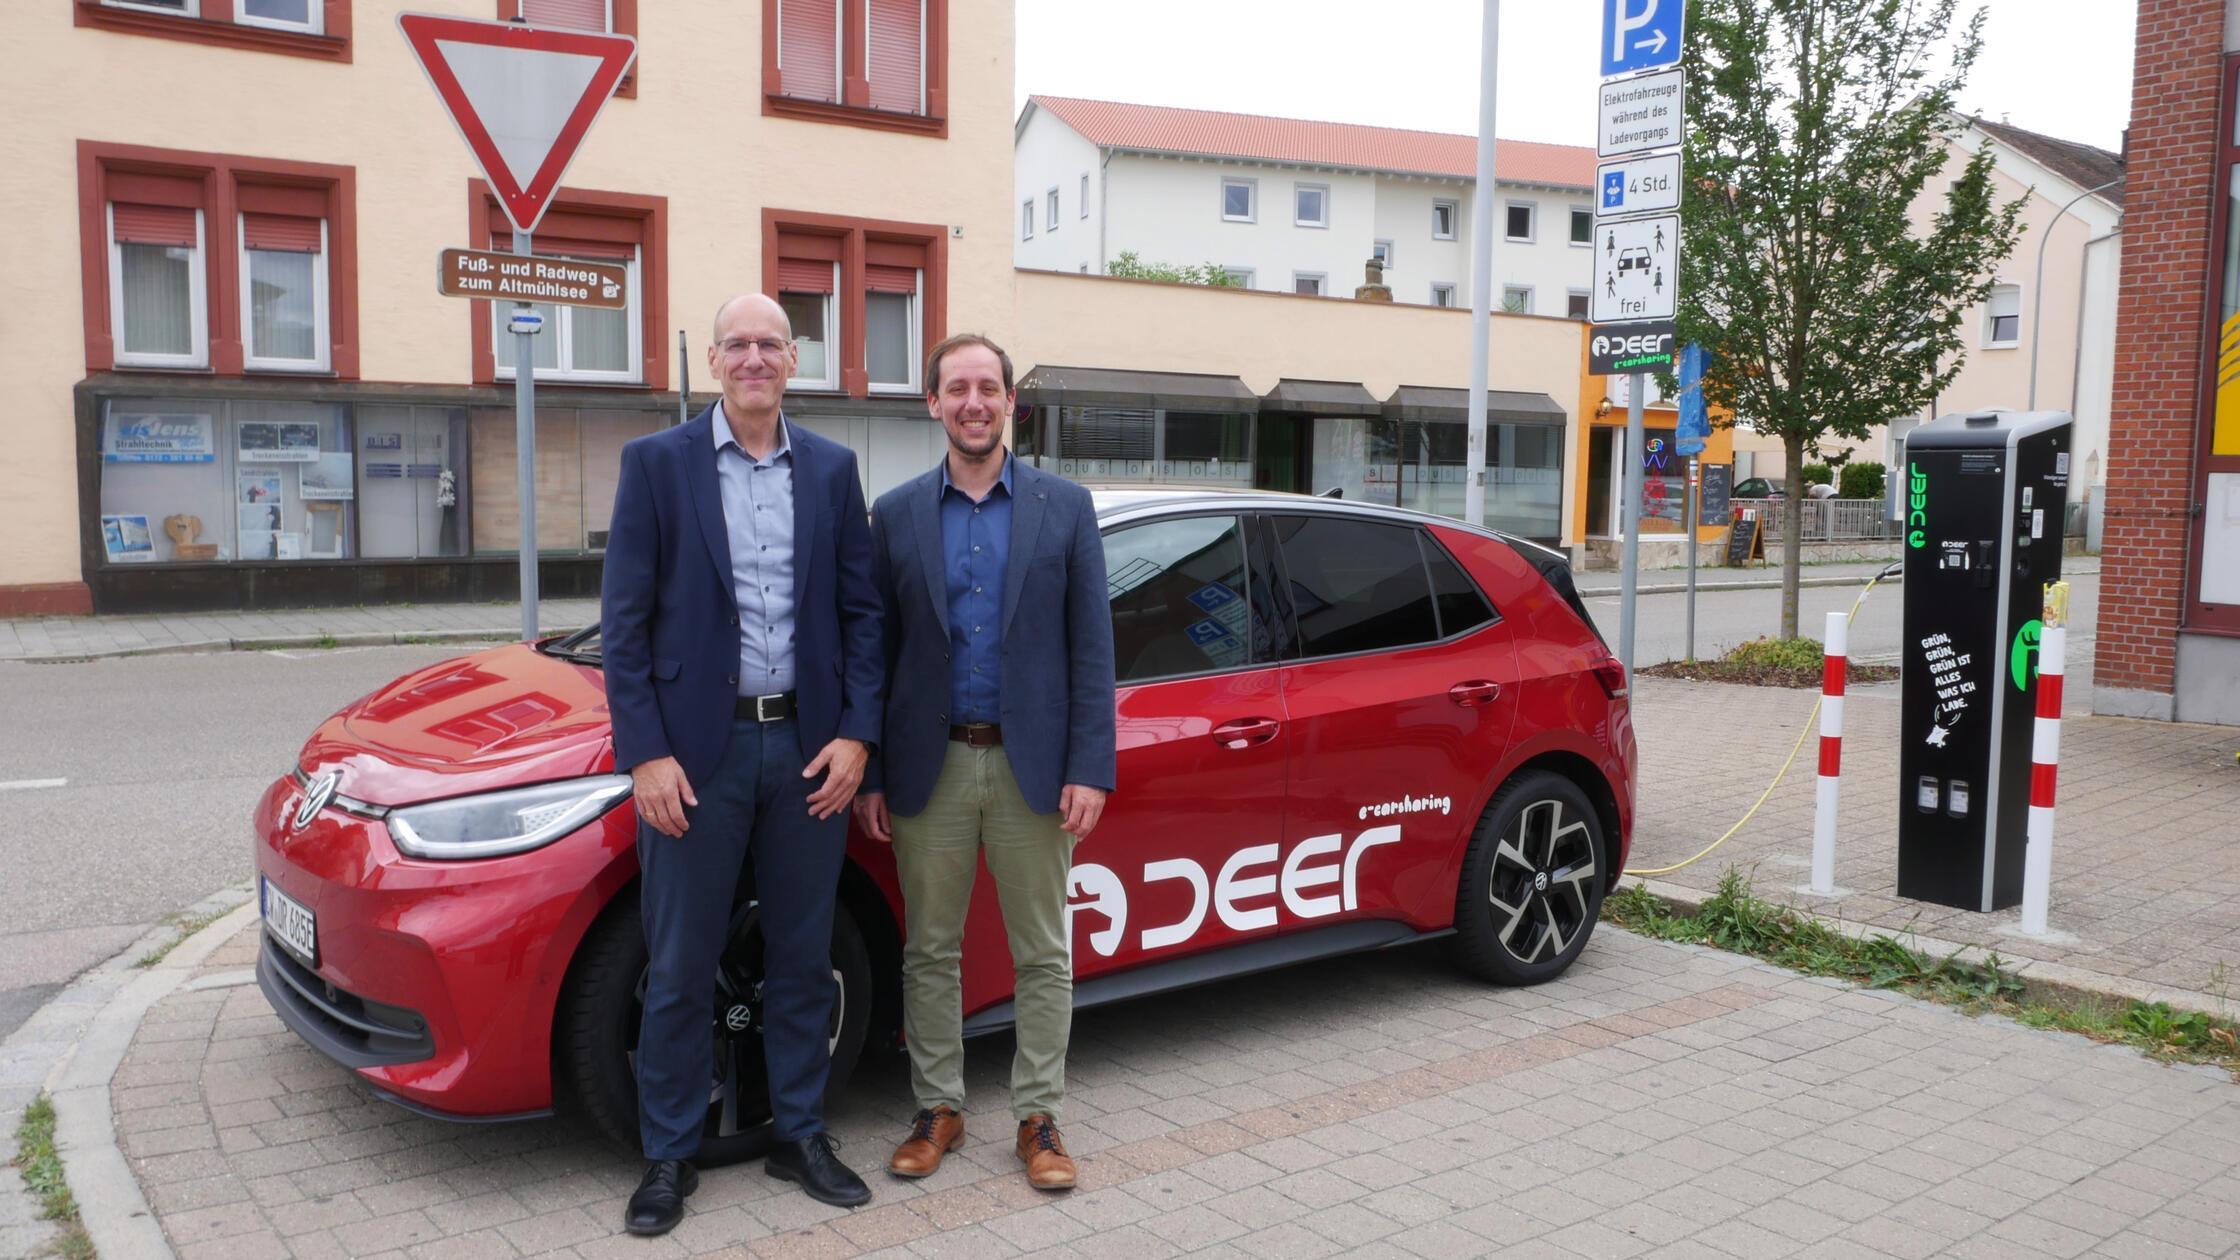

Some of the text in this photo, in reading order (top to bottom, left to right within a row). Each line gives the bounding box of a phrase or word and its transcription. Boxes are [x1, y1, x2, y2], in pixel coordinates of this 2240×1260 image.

[1613, 0, 1658, 62] P
[1604, 84, 1677, 106] Elektrofahrzeuge
[1612, 106, 1668, 124] während des
[1609, 127, 1669, 145] Ladevorgangs
[1629, 174, 1672, 194] 4 Std.
[458, 256, 598, 286] Fuß- und Radweg
[458, 277, 588, 300] zum Altmühlsee
[1621, 296, 1646, 313] frei
[1613, 353, 1671, 369] e-carsharing
[115, 439, 173, 449] Strahltechnik
[1921, 633, 1951, 649] GRÜN,
[1925, 645, 1955, 661] GRÜN,
[1929, 653, 1971, 674] GRÜN IST
[1935, 671, 1961, 687] ALLES
[1937, 681, 1976, 699] WAS ICH
[1941, 698, 1968, 712] LADE.
[1358, 793, 1451, 820] e-carsharing
[289, 906, 313, 953] 685E
